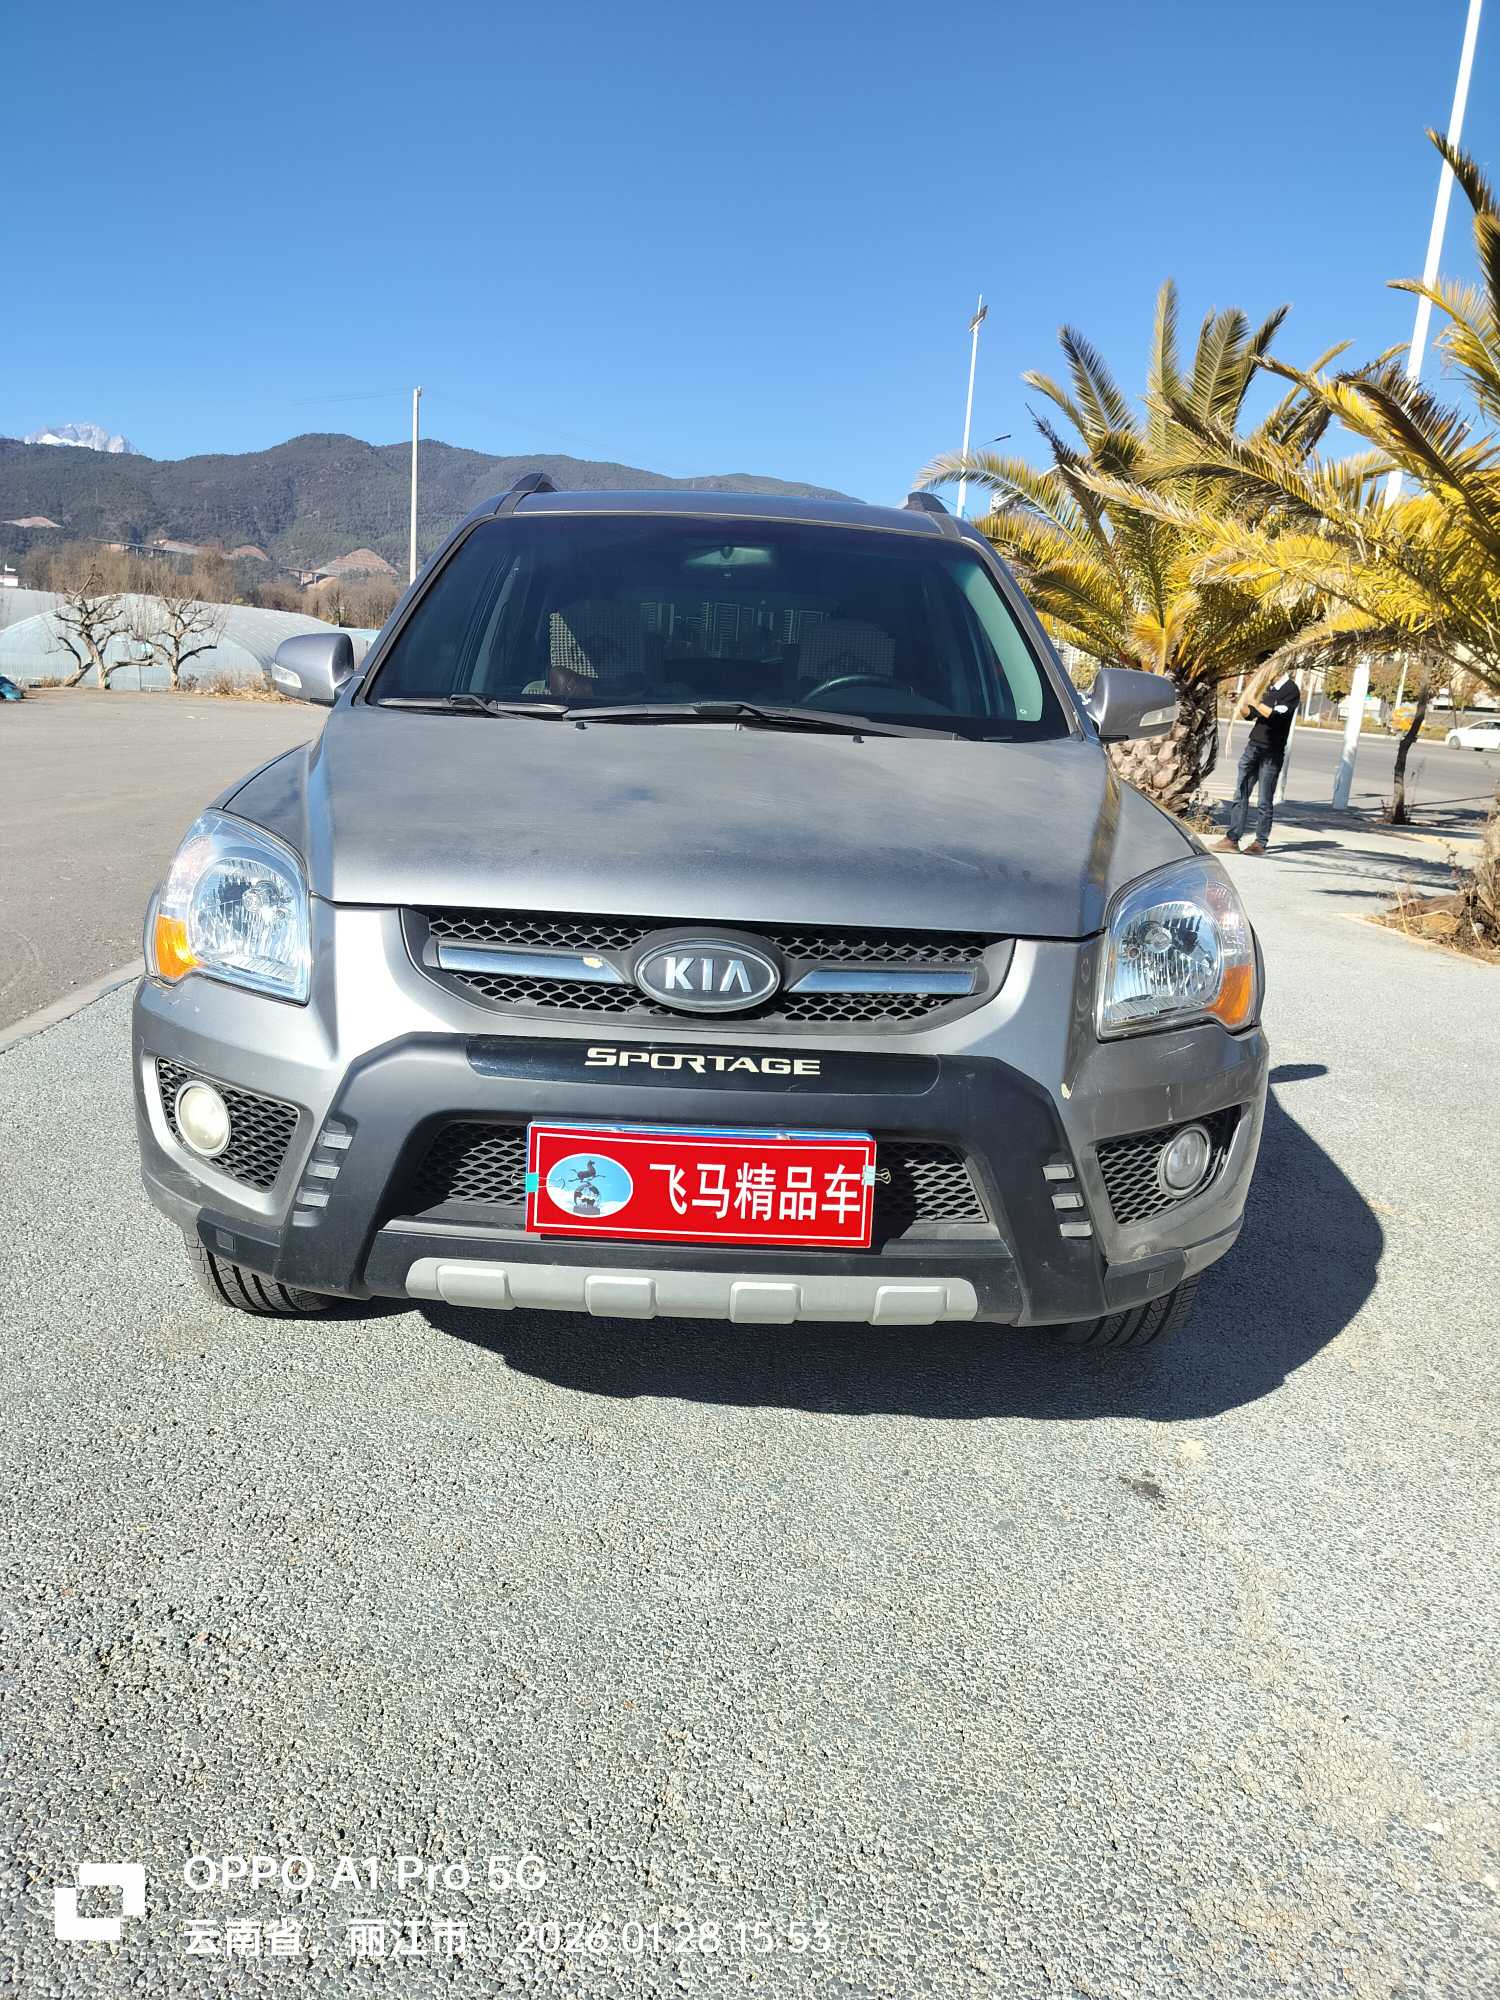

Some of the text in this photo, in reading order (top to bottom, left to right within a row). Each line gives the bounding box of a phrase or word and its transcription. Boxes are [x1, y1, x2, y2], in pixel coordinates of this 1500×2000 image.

[663, 956, 752, 993] KIA
[584, 1047, 821, 1075] SPORTAGE
[649, 1162, 861, 1224] 飞马精品车
